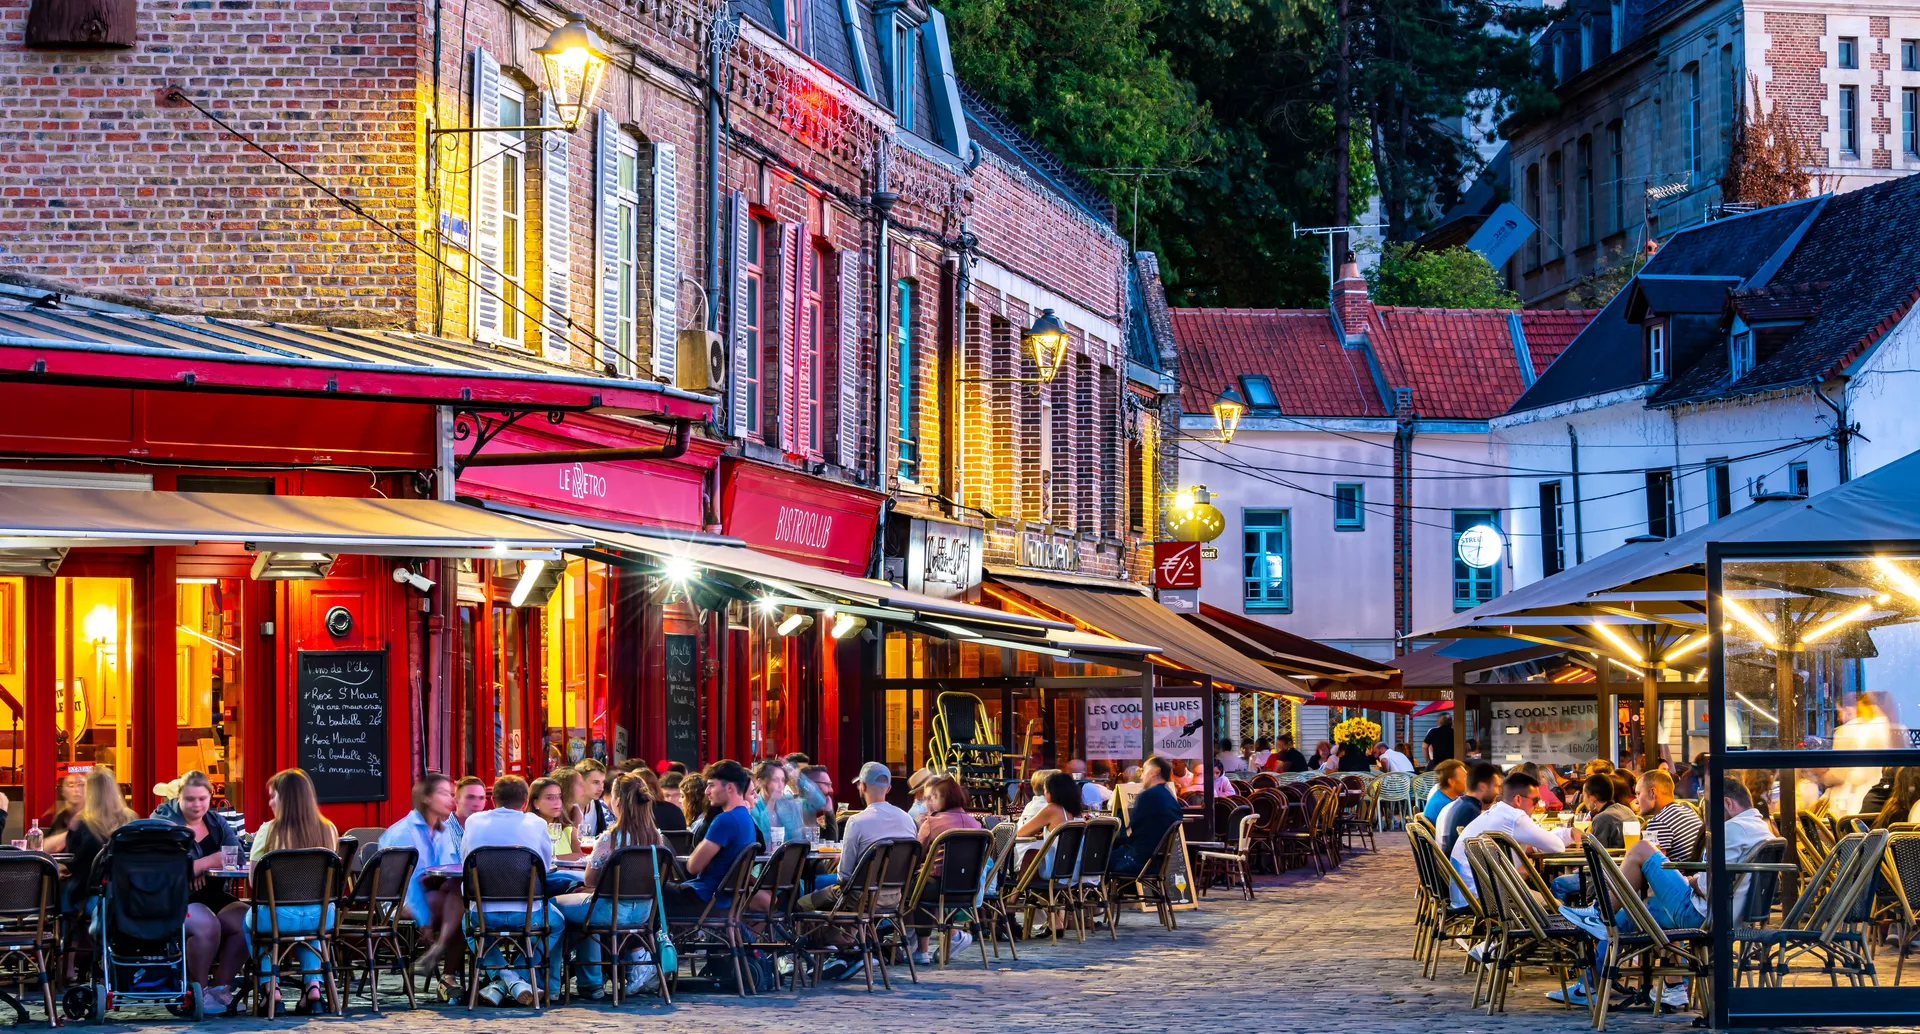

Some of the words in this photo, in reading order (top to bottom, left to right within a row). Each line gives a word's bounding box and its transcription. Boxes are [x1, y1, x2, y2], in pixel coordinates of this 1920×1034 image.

[559, 468, 570, 491] LE
[775, 506, 833, 549] BISTROCLUB
[331, 662, 342, 674] de
[311, 687, 333, 701] Rosé
[350, 687, 379, 700] Maur
[1087, 705, 1107, 716] LES
[1110, 703, 1143, 714] COOL
[1155, 700, 1200, 712] HEURES
[1490, 709, 1511, 719] LES
[1514, 706, 1558, 719] COOL'S
[316, 714, 326, 726] la
[328, 713, 361, 726] bouteille
[1101, 720, 1119, 731] DU
[1121, 715, 1188, 730] COLEUR
[1526, 719, 1595, 734] COULEUR
[311, 733, 331, 745] Rosé
[1162, 738, 1192, 750] 16h/20h
[316, 747, 326, 760] la
[328, 747, 361, 760] bouteille
